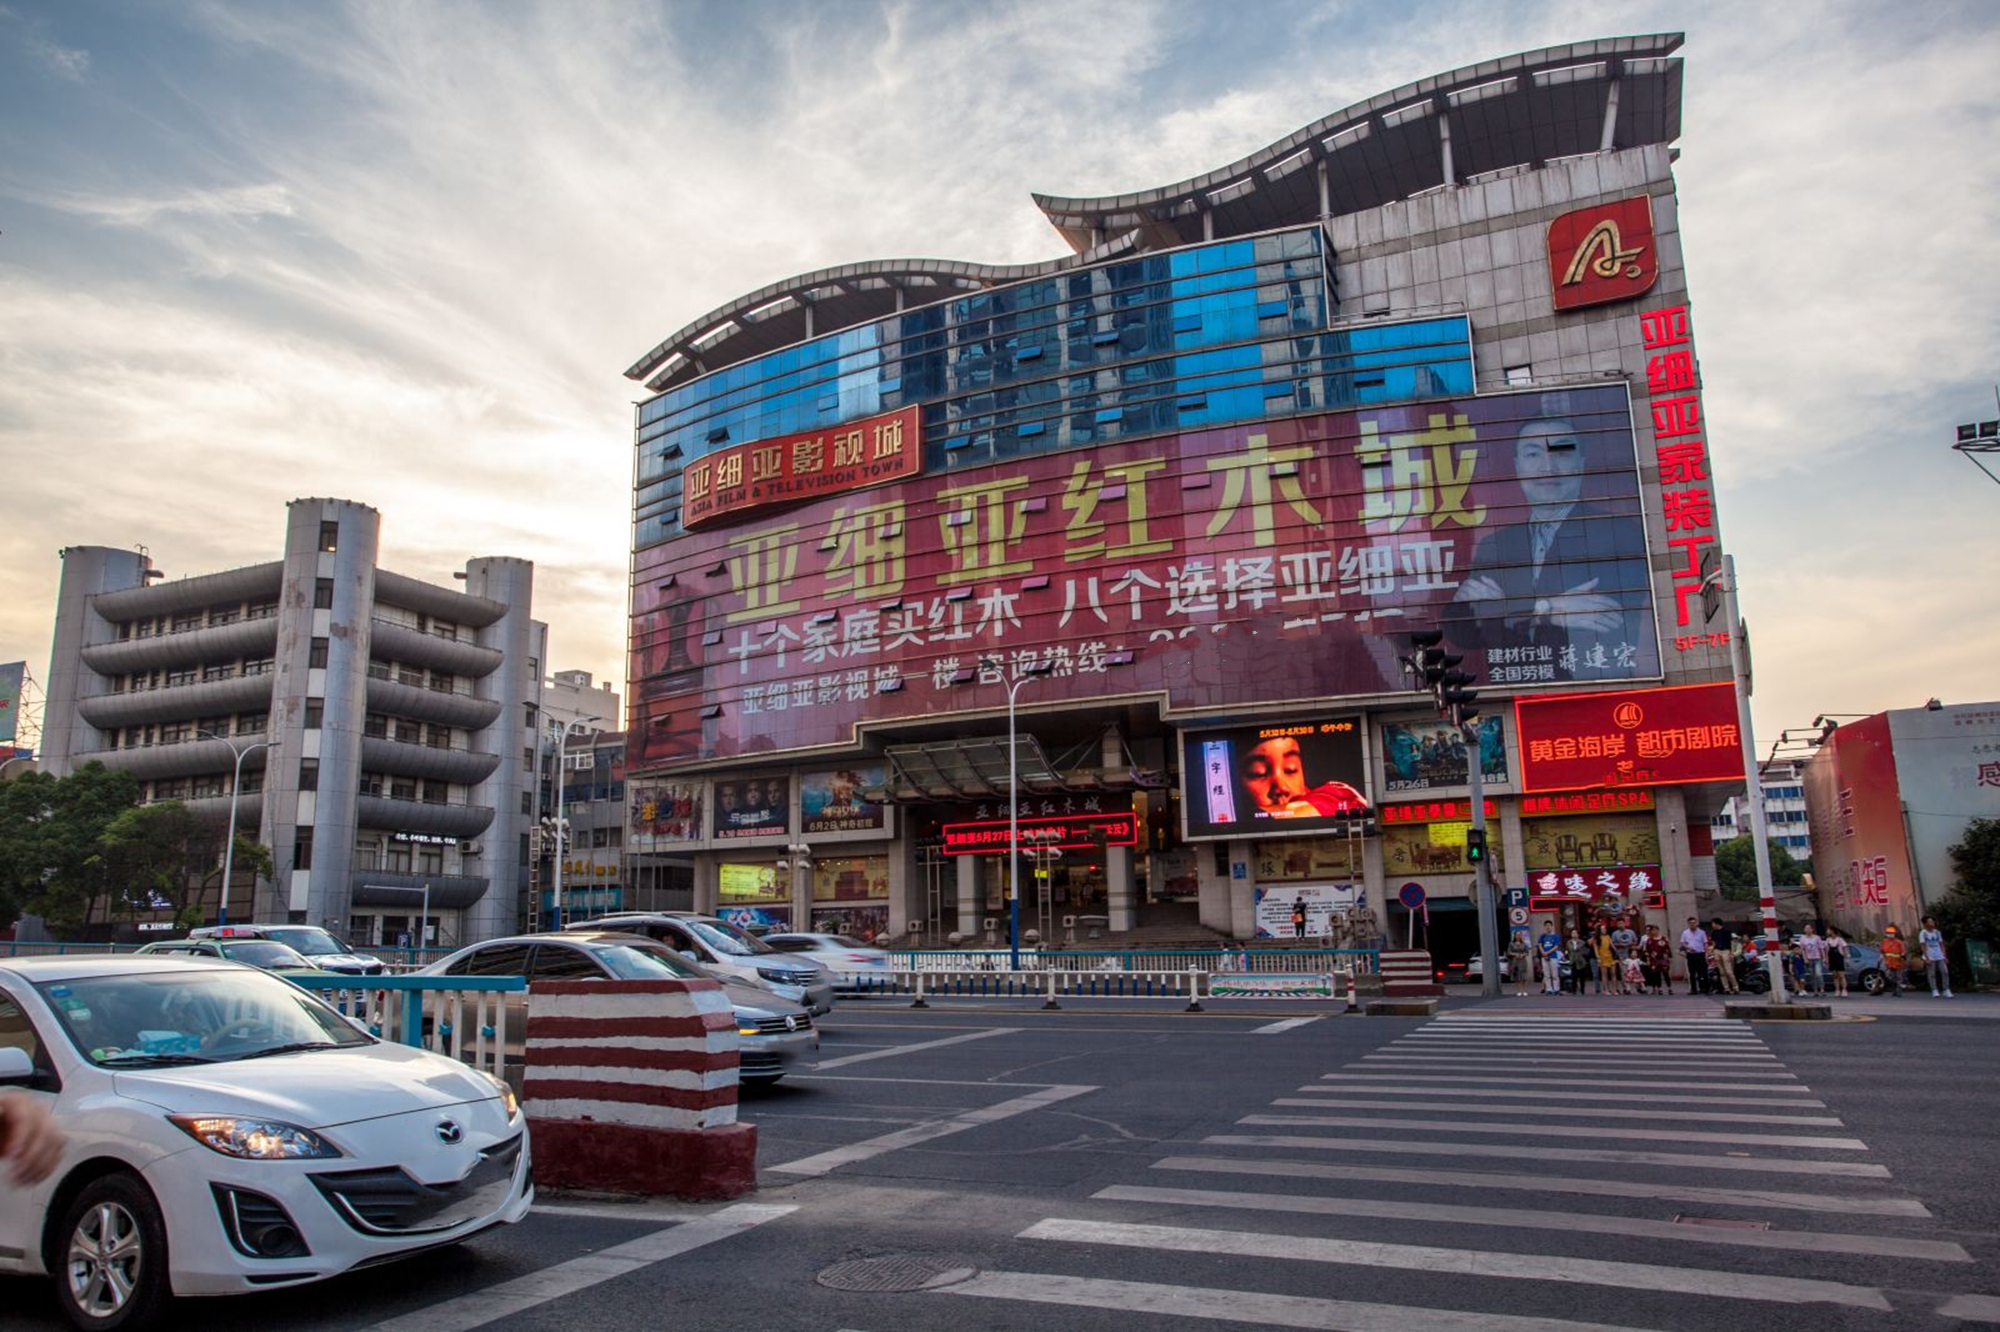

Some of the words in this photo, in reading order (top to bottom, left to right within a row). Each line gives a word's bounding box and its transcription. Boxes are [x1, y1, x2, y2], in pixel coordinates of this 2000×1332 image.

[690, 420, 905, 501] 亚细亚影视城
[717, 489, 747, 508] FILM
[768, 469, 856, 495] TELEVISION
[862, 458, 904, 478] TOWN
[725, 413, 1487, 624] 亚细亚红木城
[728, 586, 1022, 676] 十个家庭买红木
[1060, 540, 1460, 630] 八个选择亚细亚
[1488, 645, 1553, 664] 建材行业
[1489, 664, 1555, 682] 全国劳模
[742, 657, 961, 715] 亚细亚影视城一楼
[1529, 733, 1626, 761] 黄金海岸
[1636, 724, 1738, 752] 都市剧院
[1388, 778, 1430, 791] 5月26日
[1511, 890, 1523, 905] P
[1515, 911, 1524, 922] 5
